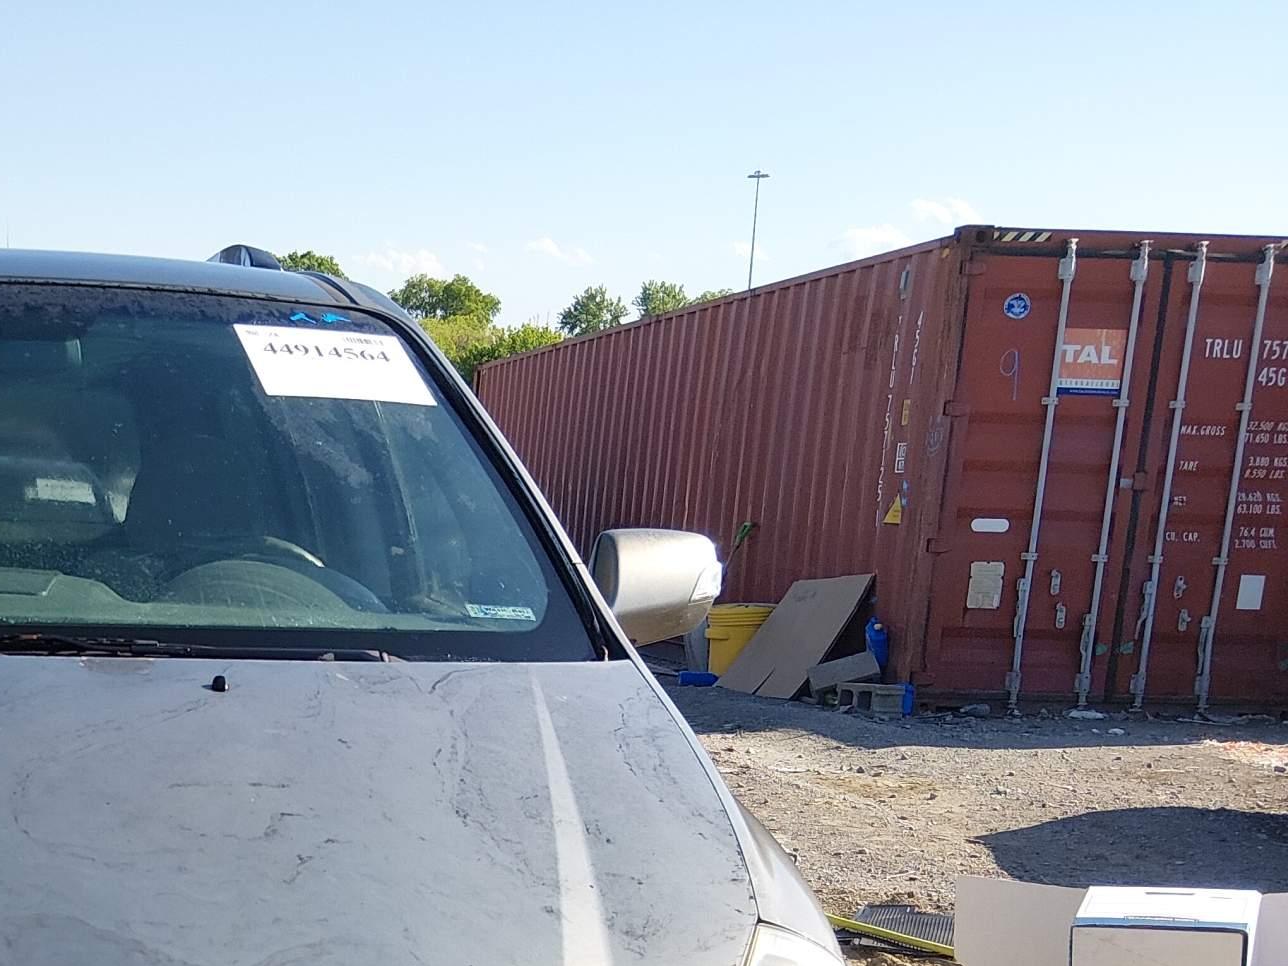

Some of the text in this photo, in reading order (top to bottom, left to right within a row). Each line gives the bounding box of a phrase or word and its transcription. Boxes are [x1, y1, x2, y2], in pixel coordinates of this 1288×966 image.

[263, 341, 391, 362] 44914564
[889, 315, 903, 388] TRLU
[1060, 344, 1119, 365] TAL
[1205, 338, 1243, 358] TRLU
[1257, 367, 1287, 387] 45G
